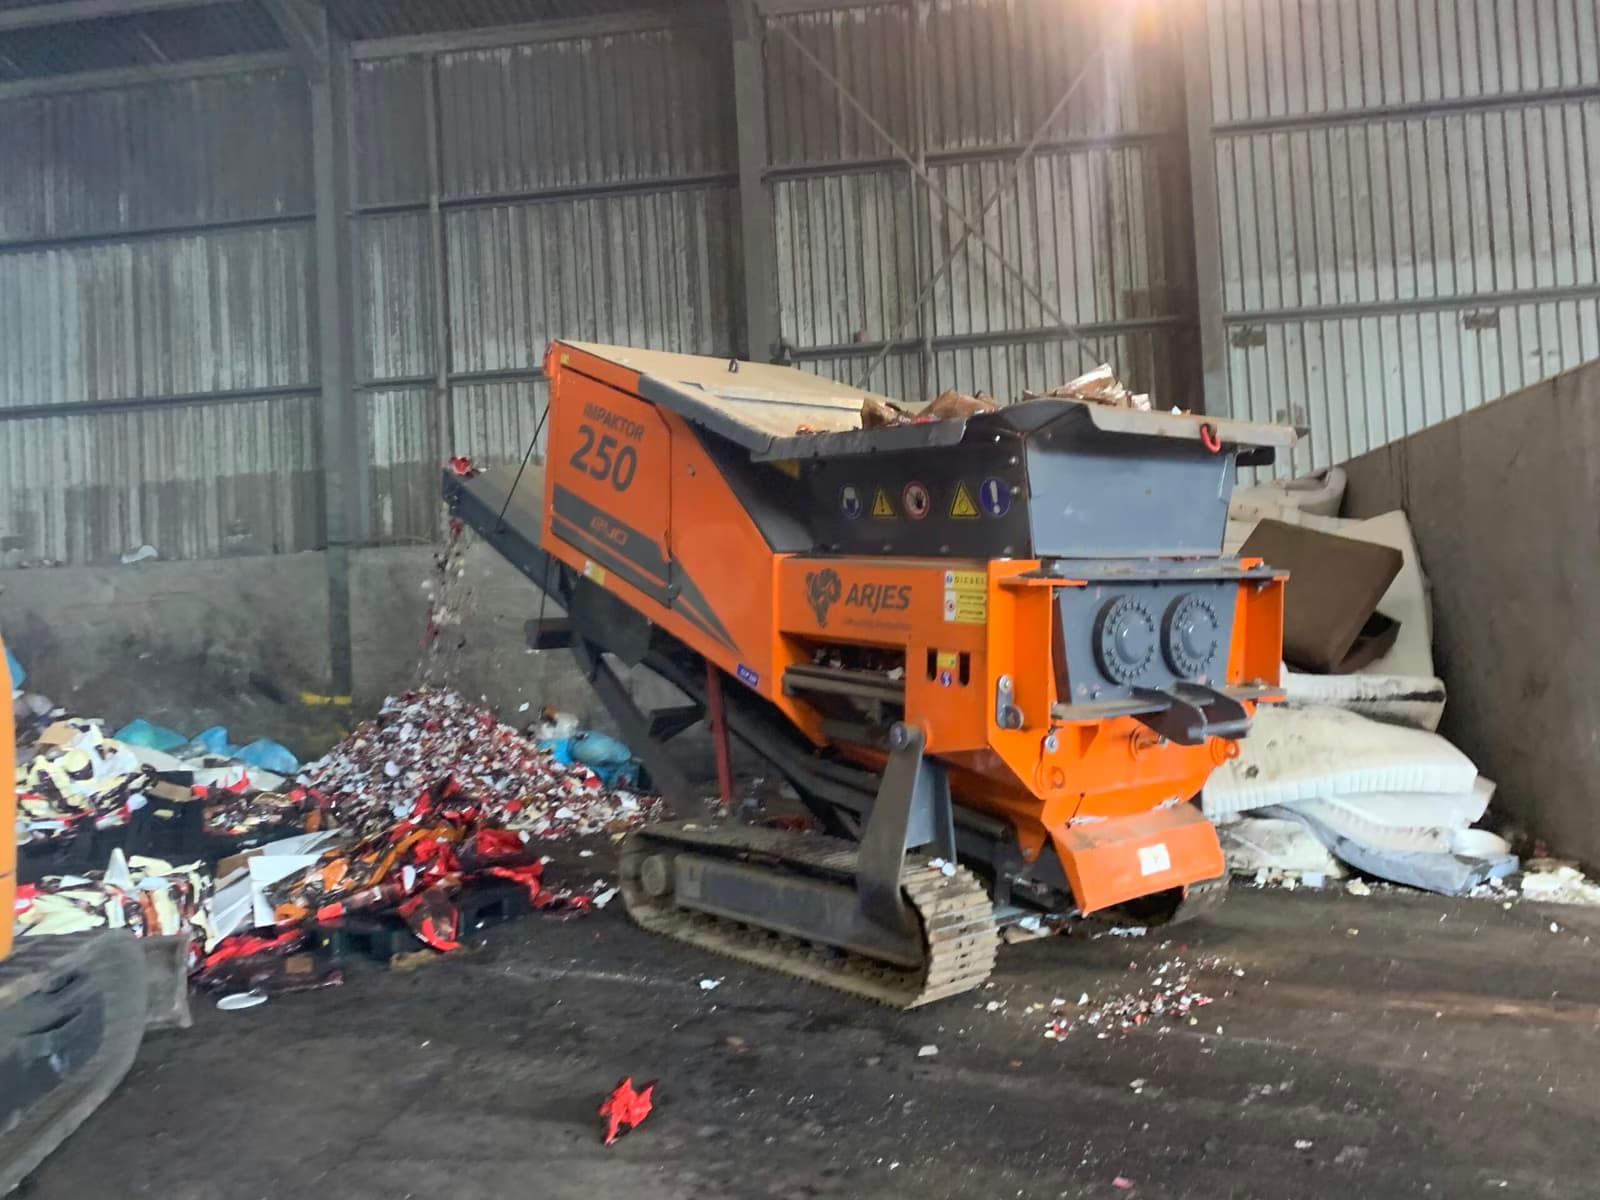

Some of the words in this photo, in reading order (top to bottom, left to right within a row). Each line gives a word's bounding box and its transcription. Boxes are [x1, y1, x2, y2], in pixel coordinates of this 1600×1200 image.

[583, 402, 645, 441] IMPAKTOR
[569, 424, 638, 492] 250
[844, 582, 912, 615] ARJES
